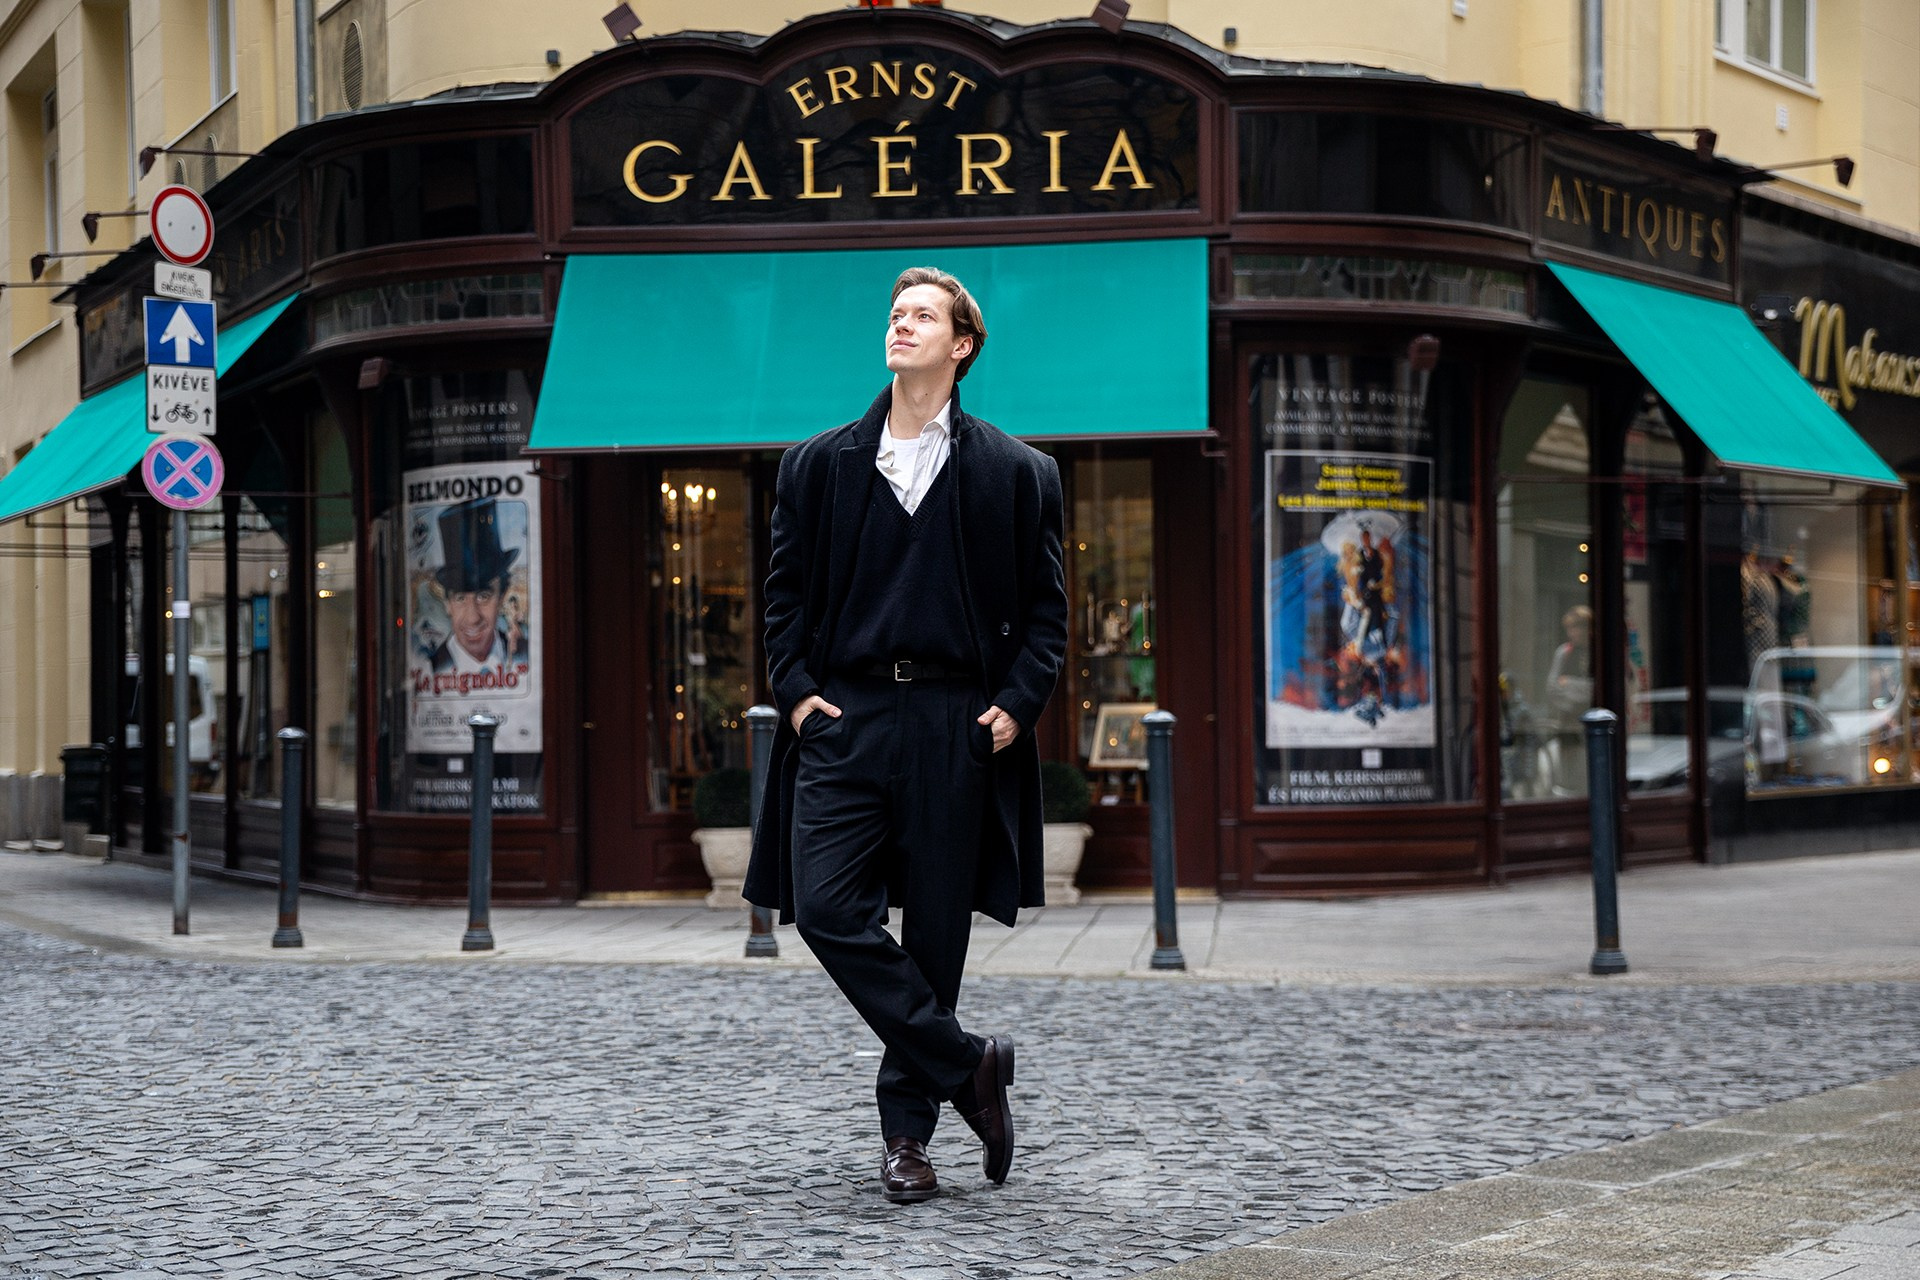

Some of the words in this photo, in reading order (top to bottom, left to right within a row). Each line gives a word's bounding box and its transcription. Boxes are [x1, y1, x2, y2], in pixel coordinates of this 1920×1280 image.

[785, 60, 977, 119] ERNST
[621, 120, 1155, 203] GALÉRIA
[1544, 173, 1727, 264] ANTIQUES
[152, 370, 210, 393] KIVÉVE
